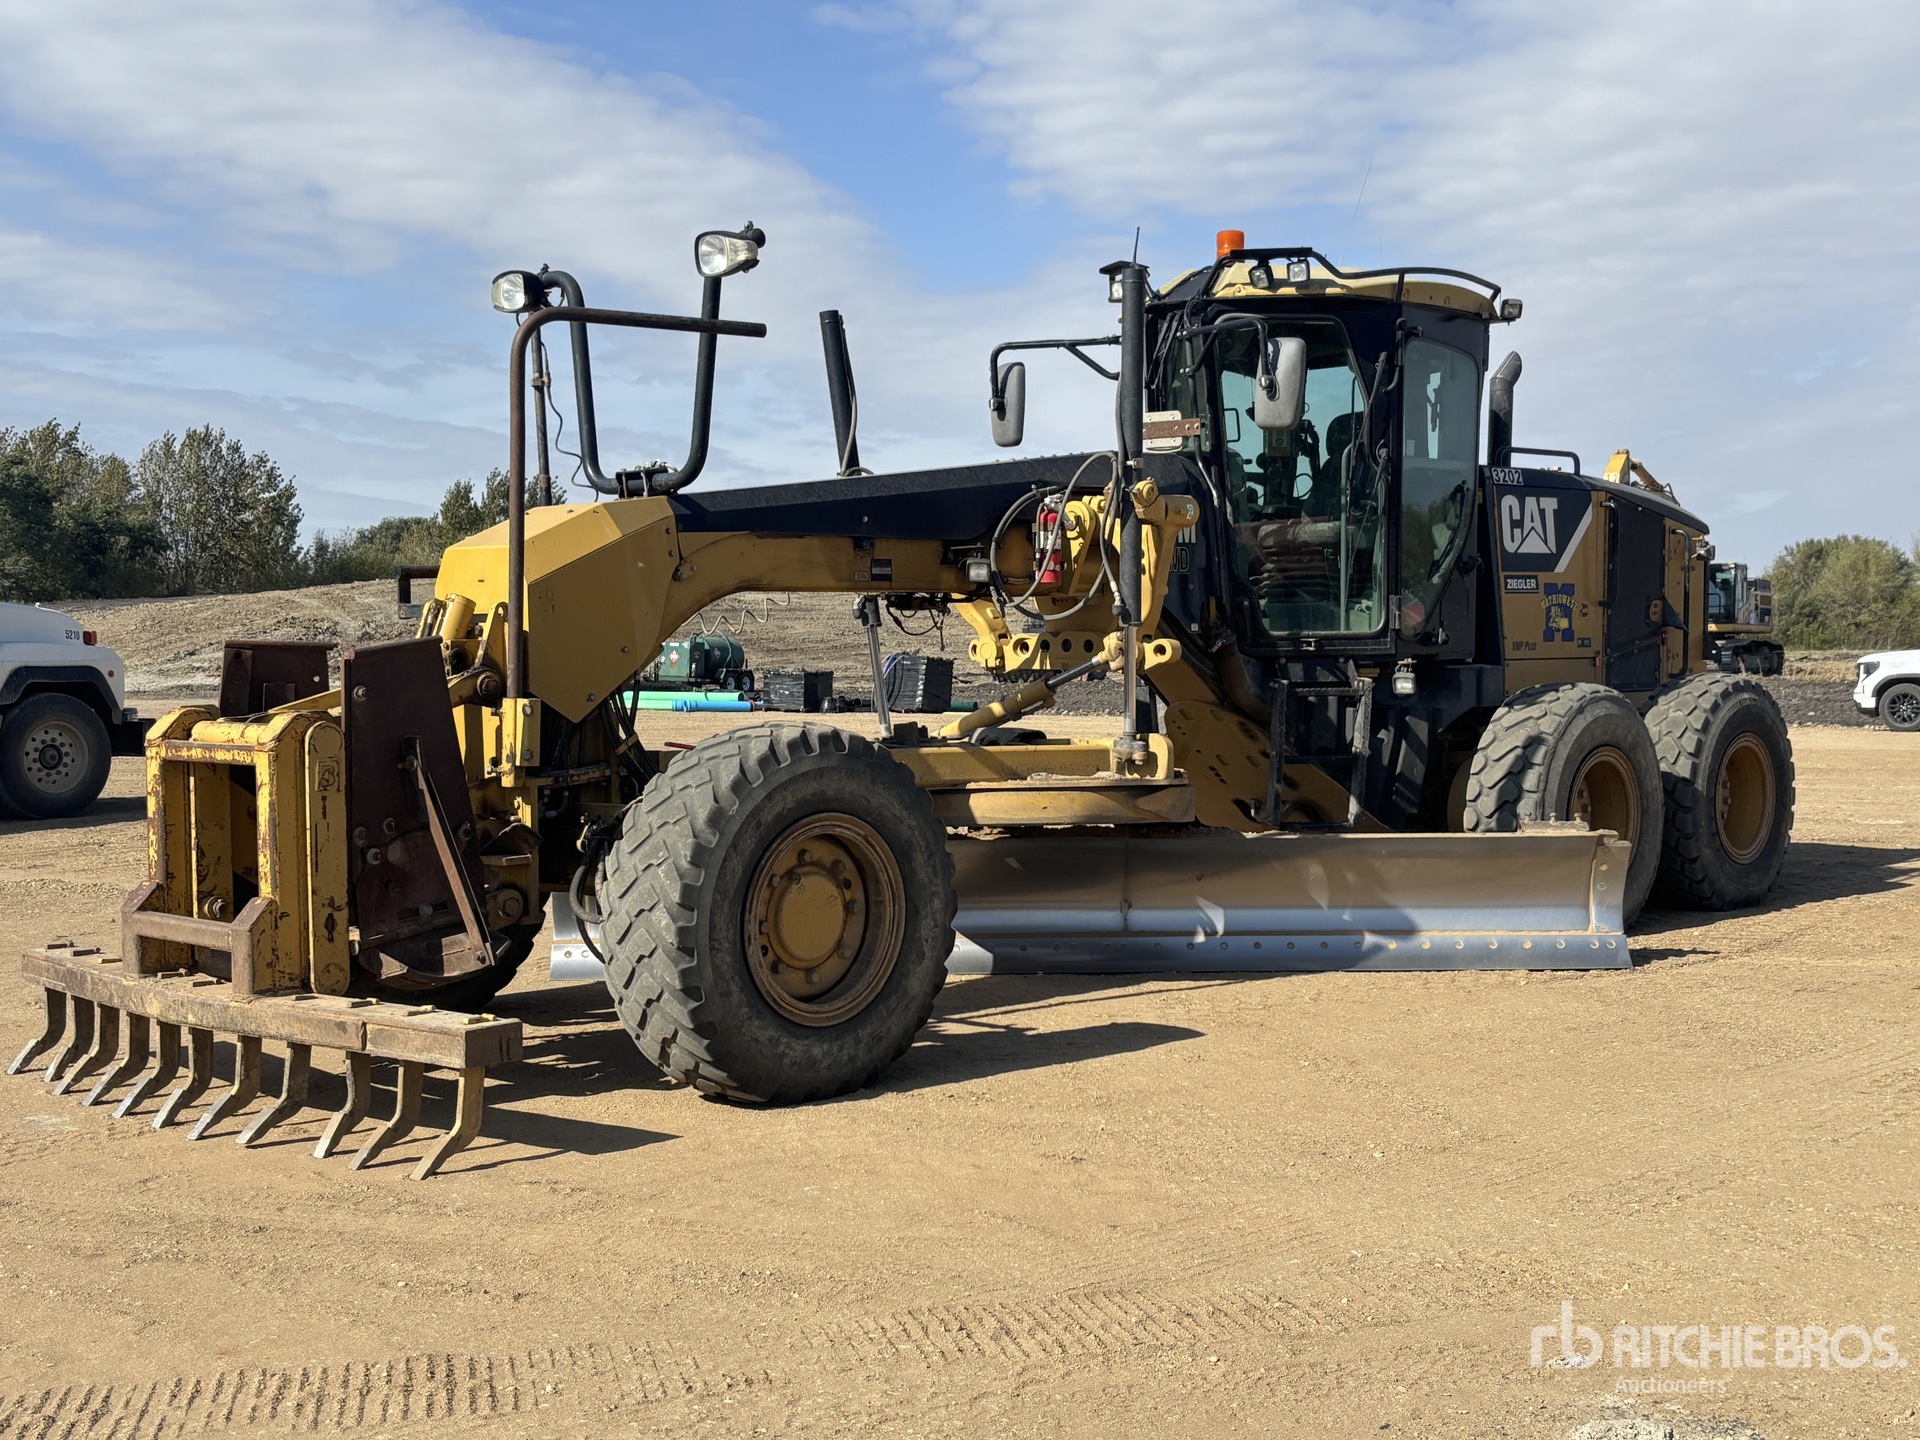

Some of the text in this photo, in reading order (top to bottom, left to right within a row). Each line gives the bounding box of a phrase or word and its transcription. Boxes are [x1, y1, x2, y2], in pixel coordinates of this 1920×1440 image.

[1492, 468, 1523, 485] 3202
[1501, 494, 1558, 554] CAT
[1506, 578, 1537, 590] ZIEGLER
